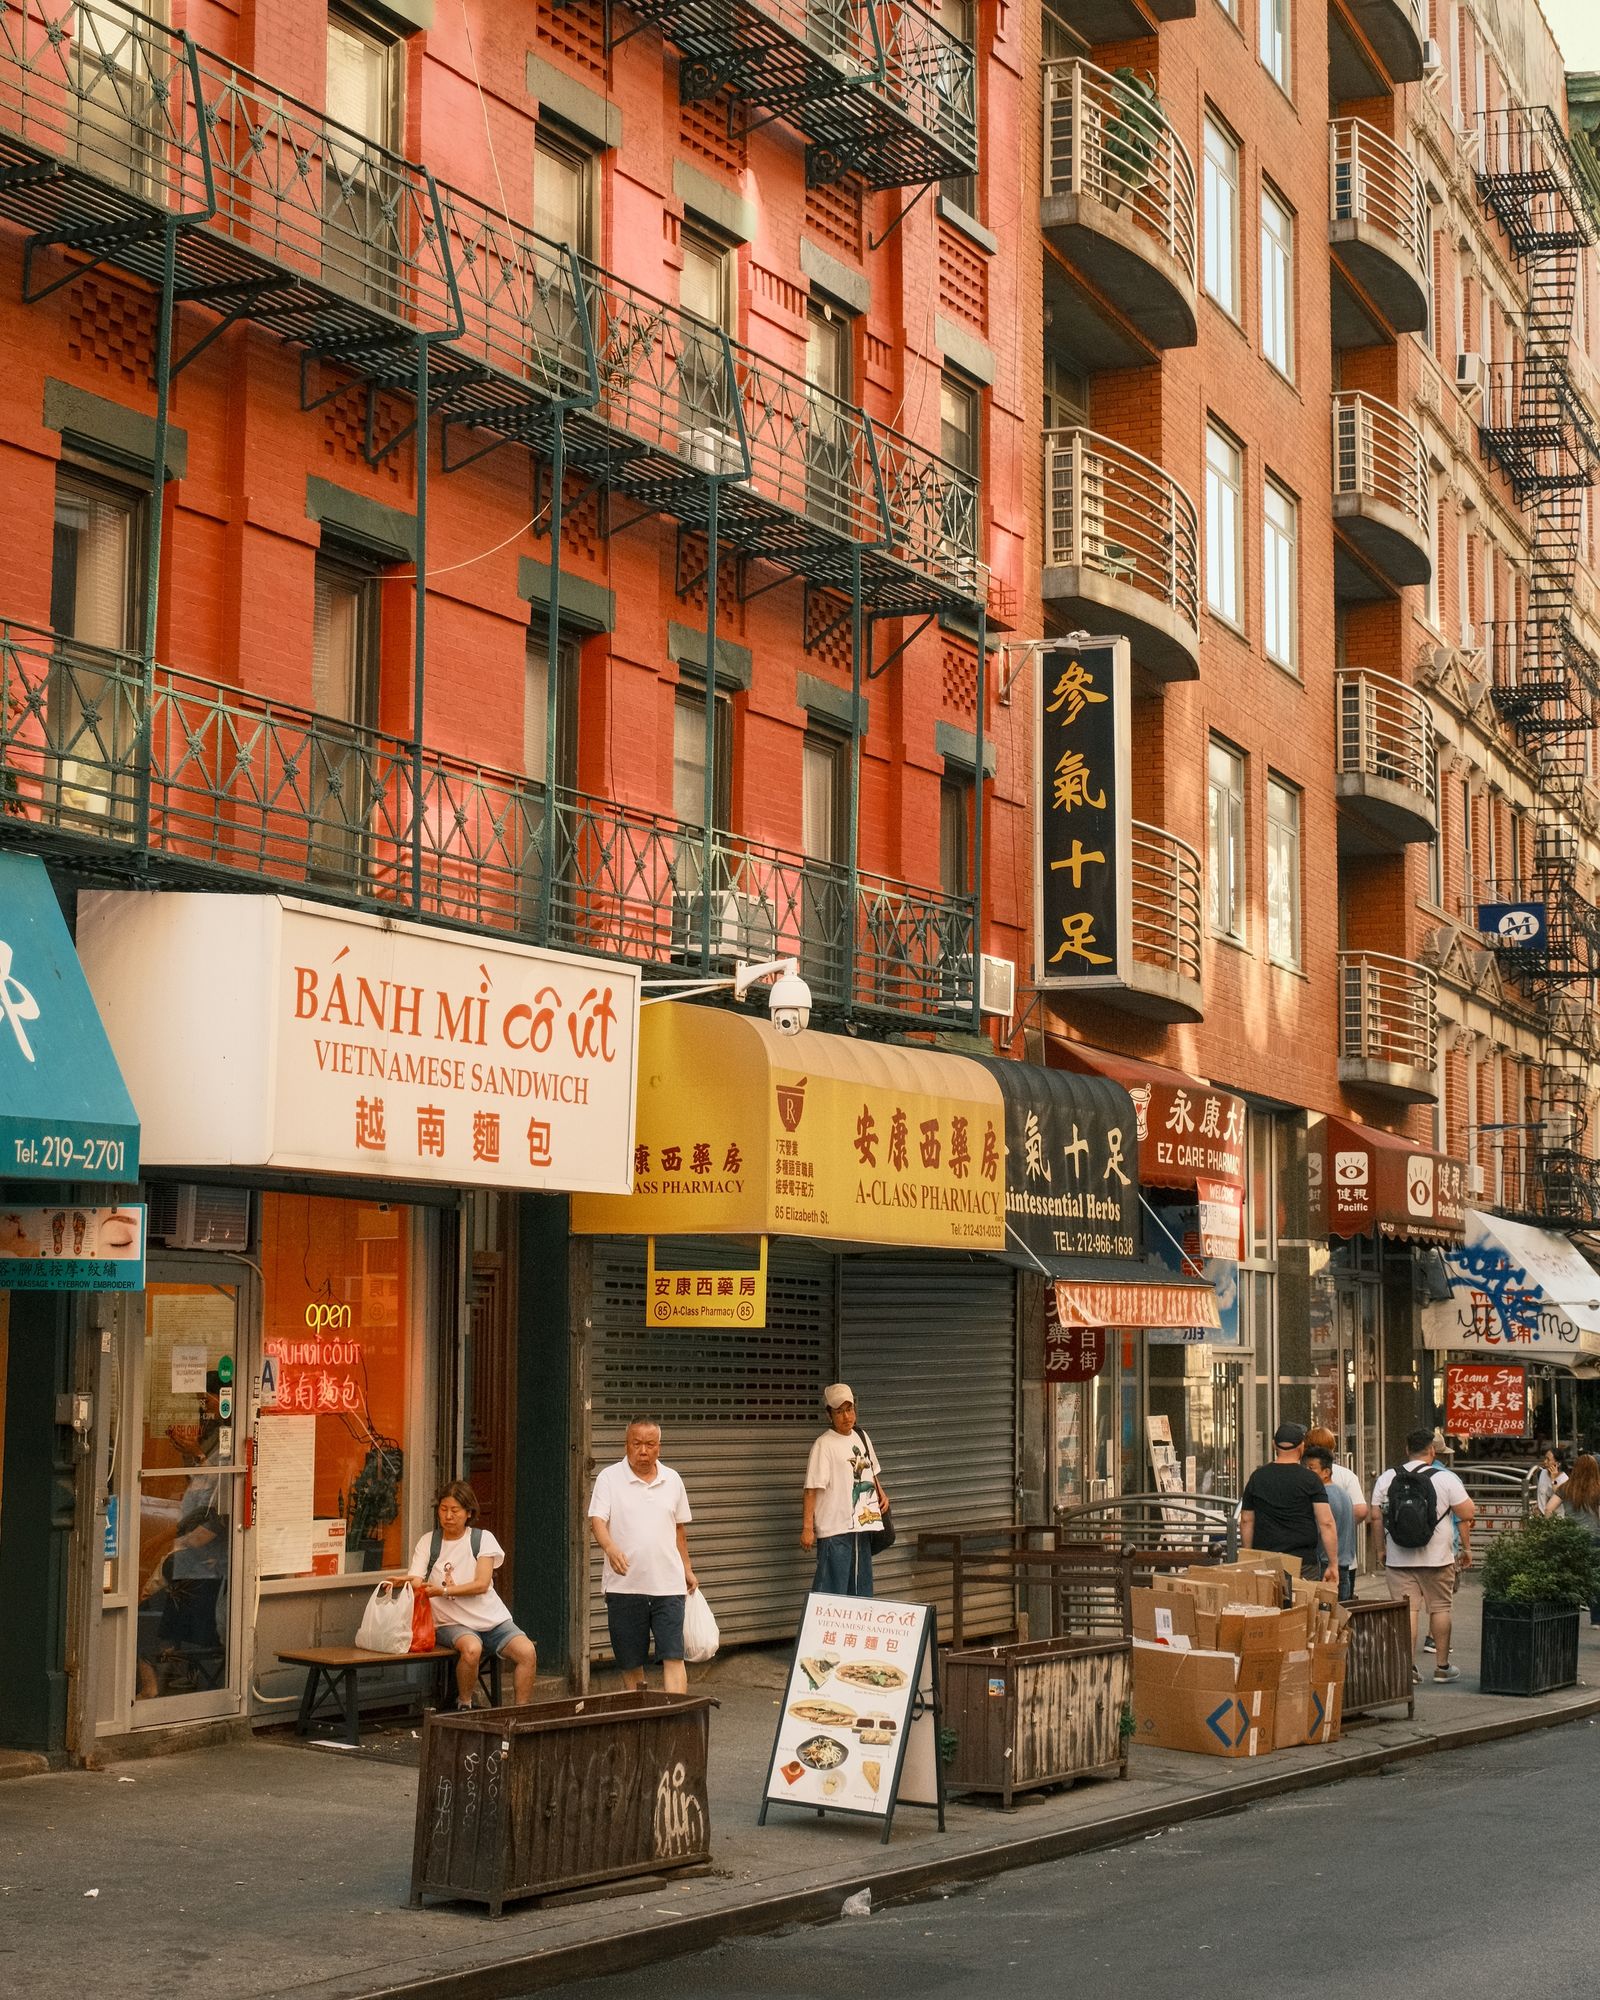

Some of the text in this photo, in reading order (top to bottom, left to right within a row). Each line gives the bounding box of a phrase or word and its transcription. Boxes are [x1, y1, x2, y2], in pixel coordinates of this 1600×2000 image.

[294, 945, 617, 1062] BÁNH MÌ cô út
[313, 1039, 589, 1104] VIETNAMESE SANDWICH
[355, 1095, 552, 1166] 越南麵包
[853, 1103, 1000, 1183] 安康西藥房
[15, 1138, 39, 1164] Tel:
[634, 1142, 743, 1175] 康西藥房
[1005, 1110, 1132, 1186] 氣十足
[1157, 1142, 1173, 1164] EZ
[1177, 1144, 1205, 1168] CARE
[661, 1180, 745, 1194] PHARMACY
[855, 1178, 1001, 1215] A-CLASS PHARMACY
[775, 1205, 830, 1224] 85 Elizabeth St.
[1005, 1186, 1121, 1222] uintessential Herbs
[1337, 1203, 1369, 1212] Pacific
[951, 1222, 1002, 1238] Tel: 212-431-0333
[1053, 1231, 1134, 1256] TEL: 212-966-1638
[17, 1281, 49, 1289] MASSAGE
[57, 1281, 91, 1289] EYEBROW
[93, 1281, 137, 1290] EMBROIDERY
[654, 1276, 756, 1297] 安康西藥房
[305, 1303, 352, 1335] open
[657, 1305, 751, 1319] 85 A-Class Pharmacy 85
[261, 1360, 275, 1392] A
[1448, 1368, 1522, 1387] Teana Spa
[1447, 1417, 1525, 1430] 646-613-1888
[815, 1602, 852, 1619] BÁNH
[817, 1619, 910, 1637] VIETNAMESE SANDWICH
[822, 1630, 899, 1653] 越南麵包
